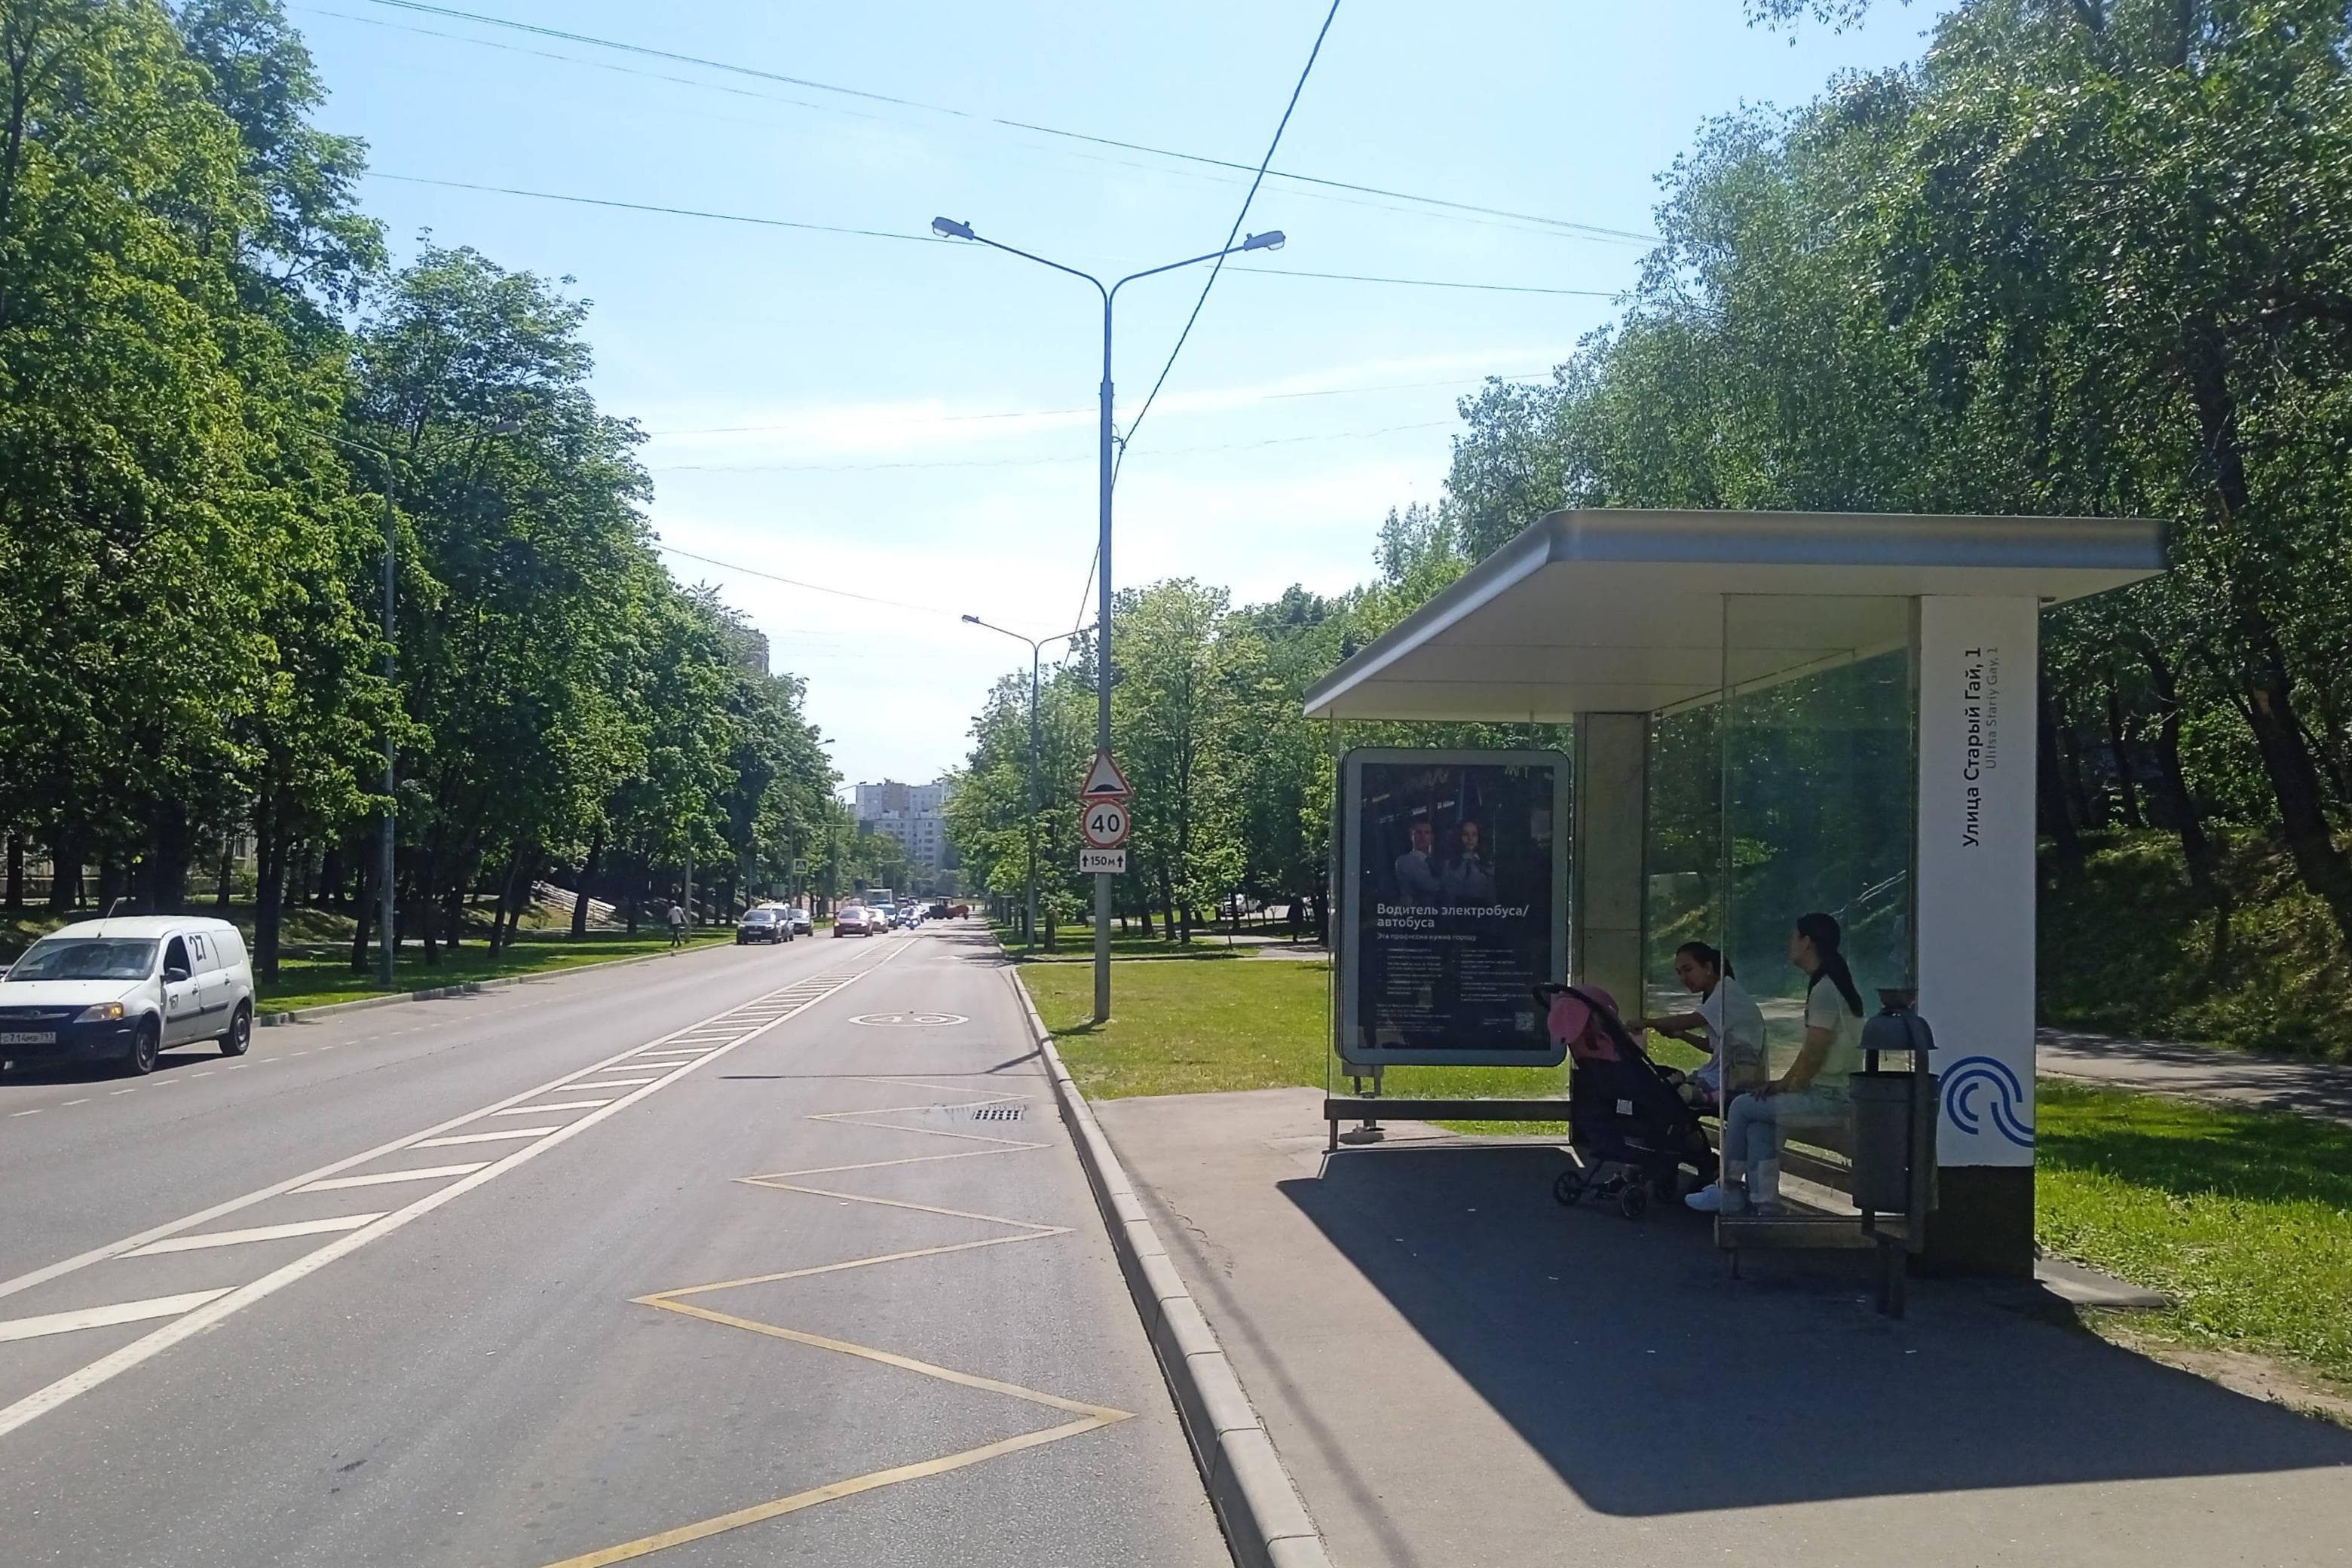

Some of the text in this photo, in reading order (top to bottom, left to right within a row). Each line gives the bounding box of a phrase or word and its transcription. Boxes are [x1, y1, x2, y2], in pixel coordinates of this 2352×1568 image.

[1986, 657, 1999, 686] Gay,
[1986, 687, 2000, 727] Stariy
[1963, 647, 1984, 847] Улица Старый Гай, 1
[1986, 730, 1997, 769] Ulitsa
[1091, 814, 1120, 833] 40
[1377, 903, 1530, 918] Водитель электробуса/
[1377, 916, 1435, 929] автобуса
[188, 934, 207, 961] 27
[871, 1015, 948, 1024] 40
